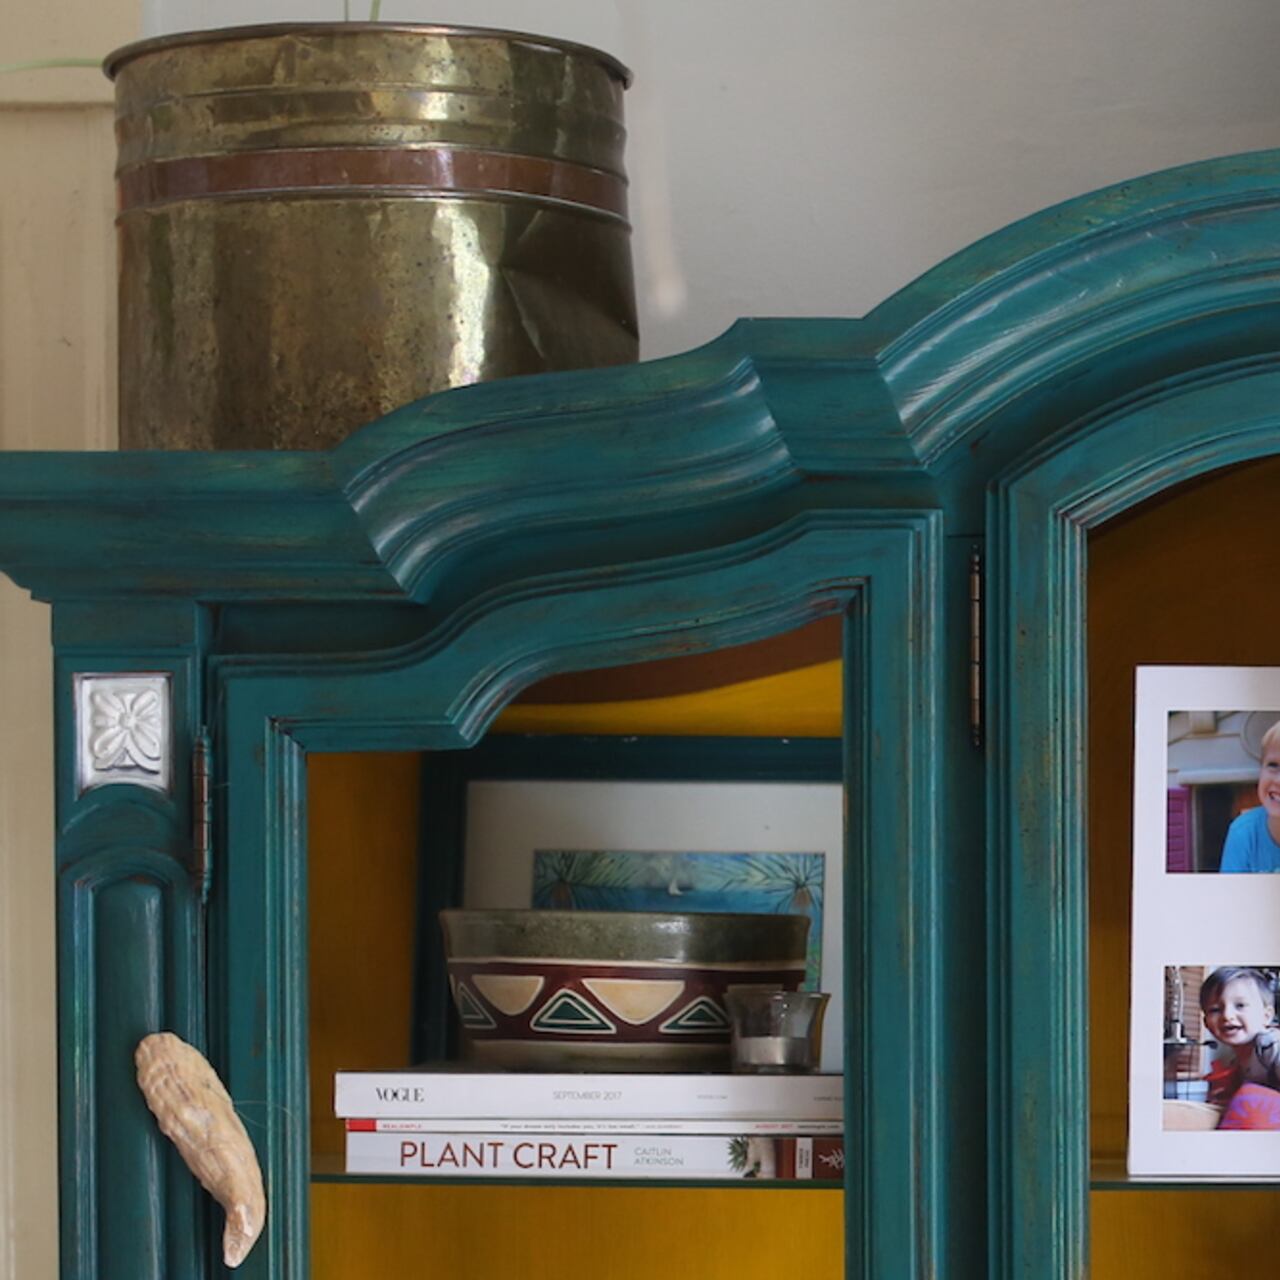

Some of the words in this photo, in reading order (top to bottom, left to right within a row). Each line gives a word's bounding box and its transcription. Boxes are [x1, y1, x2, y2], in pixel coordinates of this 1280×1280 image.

[375, 1087, 425, 1102] VOGUE
[552, 1090, 601, 1101] SEPTEMBER
[603, 1090, 622, 1101] 2017
[399, 1141, 504, 1168] PLANT
[512, 1142, 618, 1170] CRAFT
[633, 1147, 672, 1156] CAITLIN
[633, 1156, 685, 1166] ATKINSON
